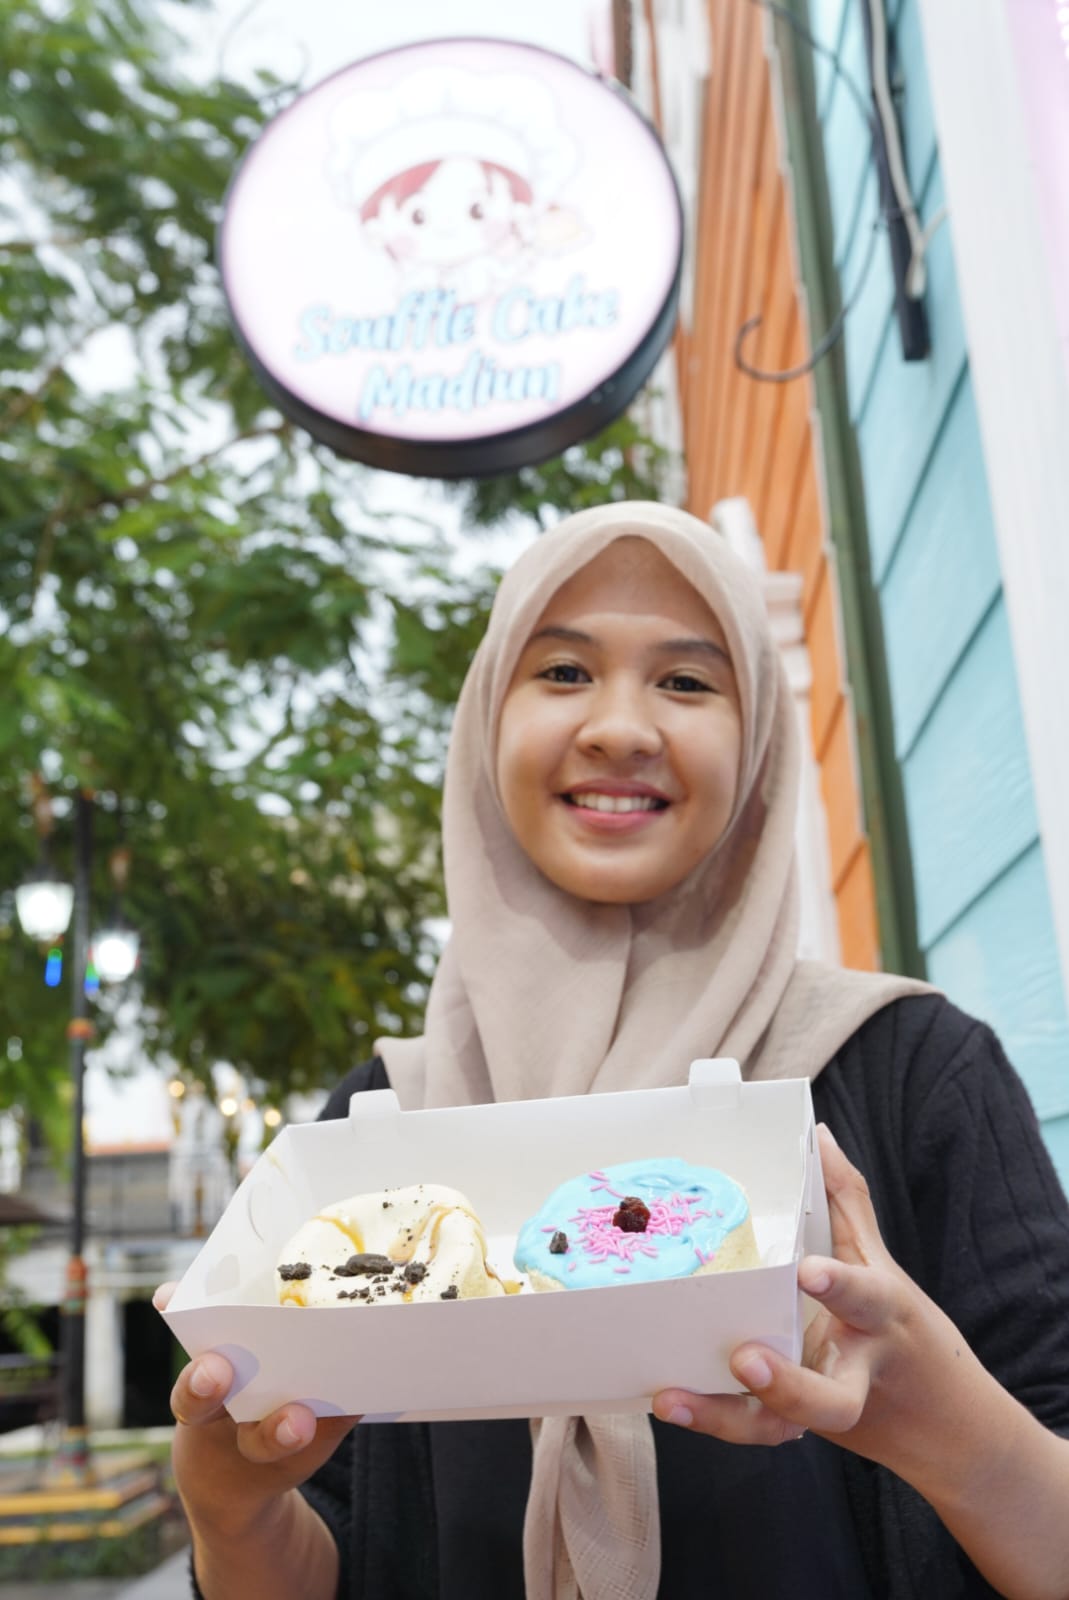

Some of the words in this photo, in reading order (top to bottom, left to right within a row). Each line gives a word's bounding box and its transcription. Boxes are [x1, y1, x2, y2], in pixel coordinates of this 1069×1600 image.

[294, 286, 476, 361] Souffle
[491, 272, 619, 343] Cake
[357, 350, 562, 422] Madiun
